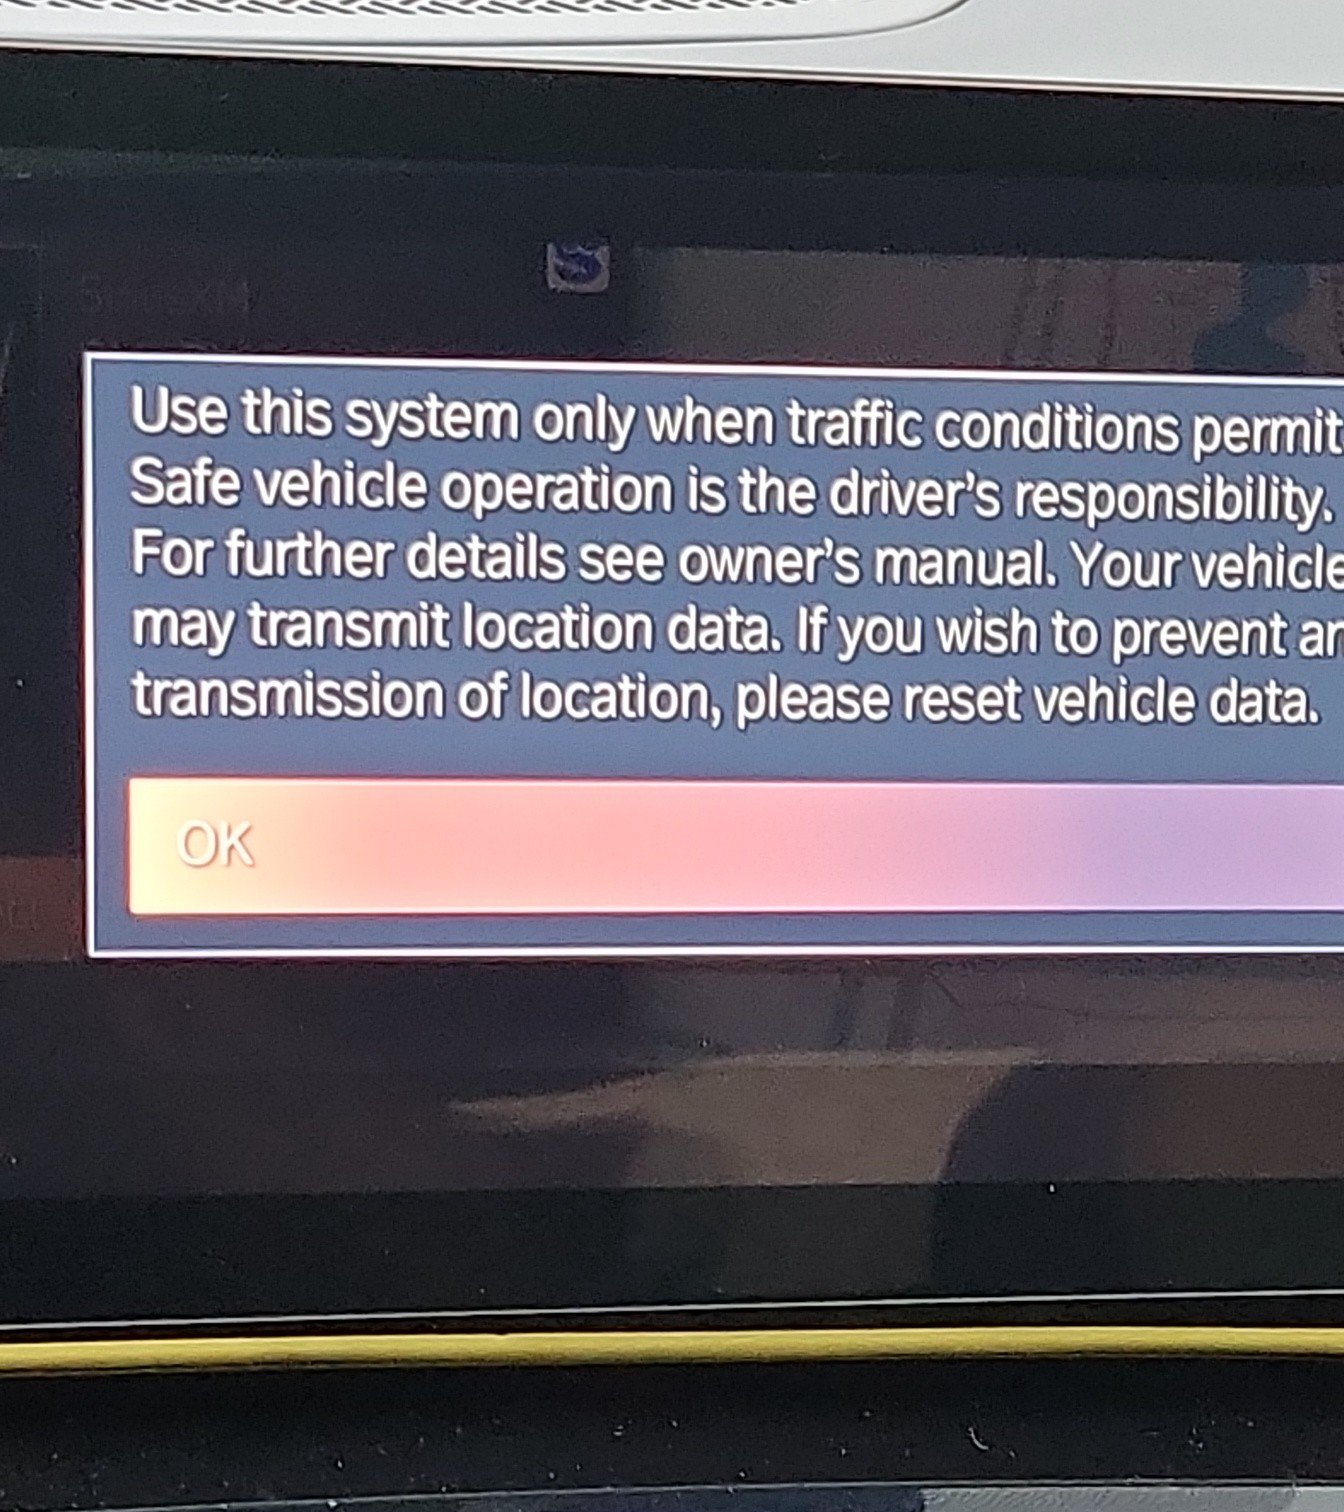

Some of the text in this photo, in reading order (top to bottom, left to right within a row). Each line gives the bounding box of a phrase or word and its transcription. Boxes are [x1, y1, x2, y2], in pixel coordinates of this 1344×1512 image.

[131, 384, 229, 436] Use
[239, 385, 334, 437] this
[344, 391, 519, 449] system
[532, 392, 637, 453] only
[644, 394, 774, 446] when
[784, 397, 924, 449] traffic
[934, 400, 1181, 453] conditions
[129, 454, 1334, 533] Safe vehicle operation is the driver's responsibility.
[132, 526, 216, 577] For
[223, 526, 396, 579] further
[405, 529, 567, 581] details
[577, 542, 665, 583] see
[678, 536, 861, 585] owner's
[874, 538, 1057, 587] manual.
[1068, 539, 1184, 589] Your
[132, 606, 237, 658] may
[245, 599, 451, 649] transmit
[462, 600, 653, 651] location
[666, 602, 782, 653] data.
[797, 603, 830, 653] If
[835, 614, 923, 663] you
[934, 605, 1038, 655] wish
[1050, 608, 1099, 656] to
[1112, 610, 1289, 666] prevent
[129, 668, 1320, 731] transmission of location, please reset vehicle data.
[175, 818, 255, 868] OK
